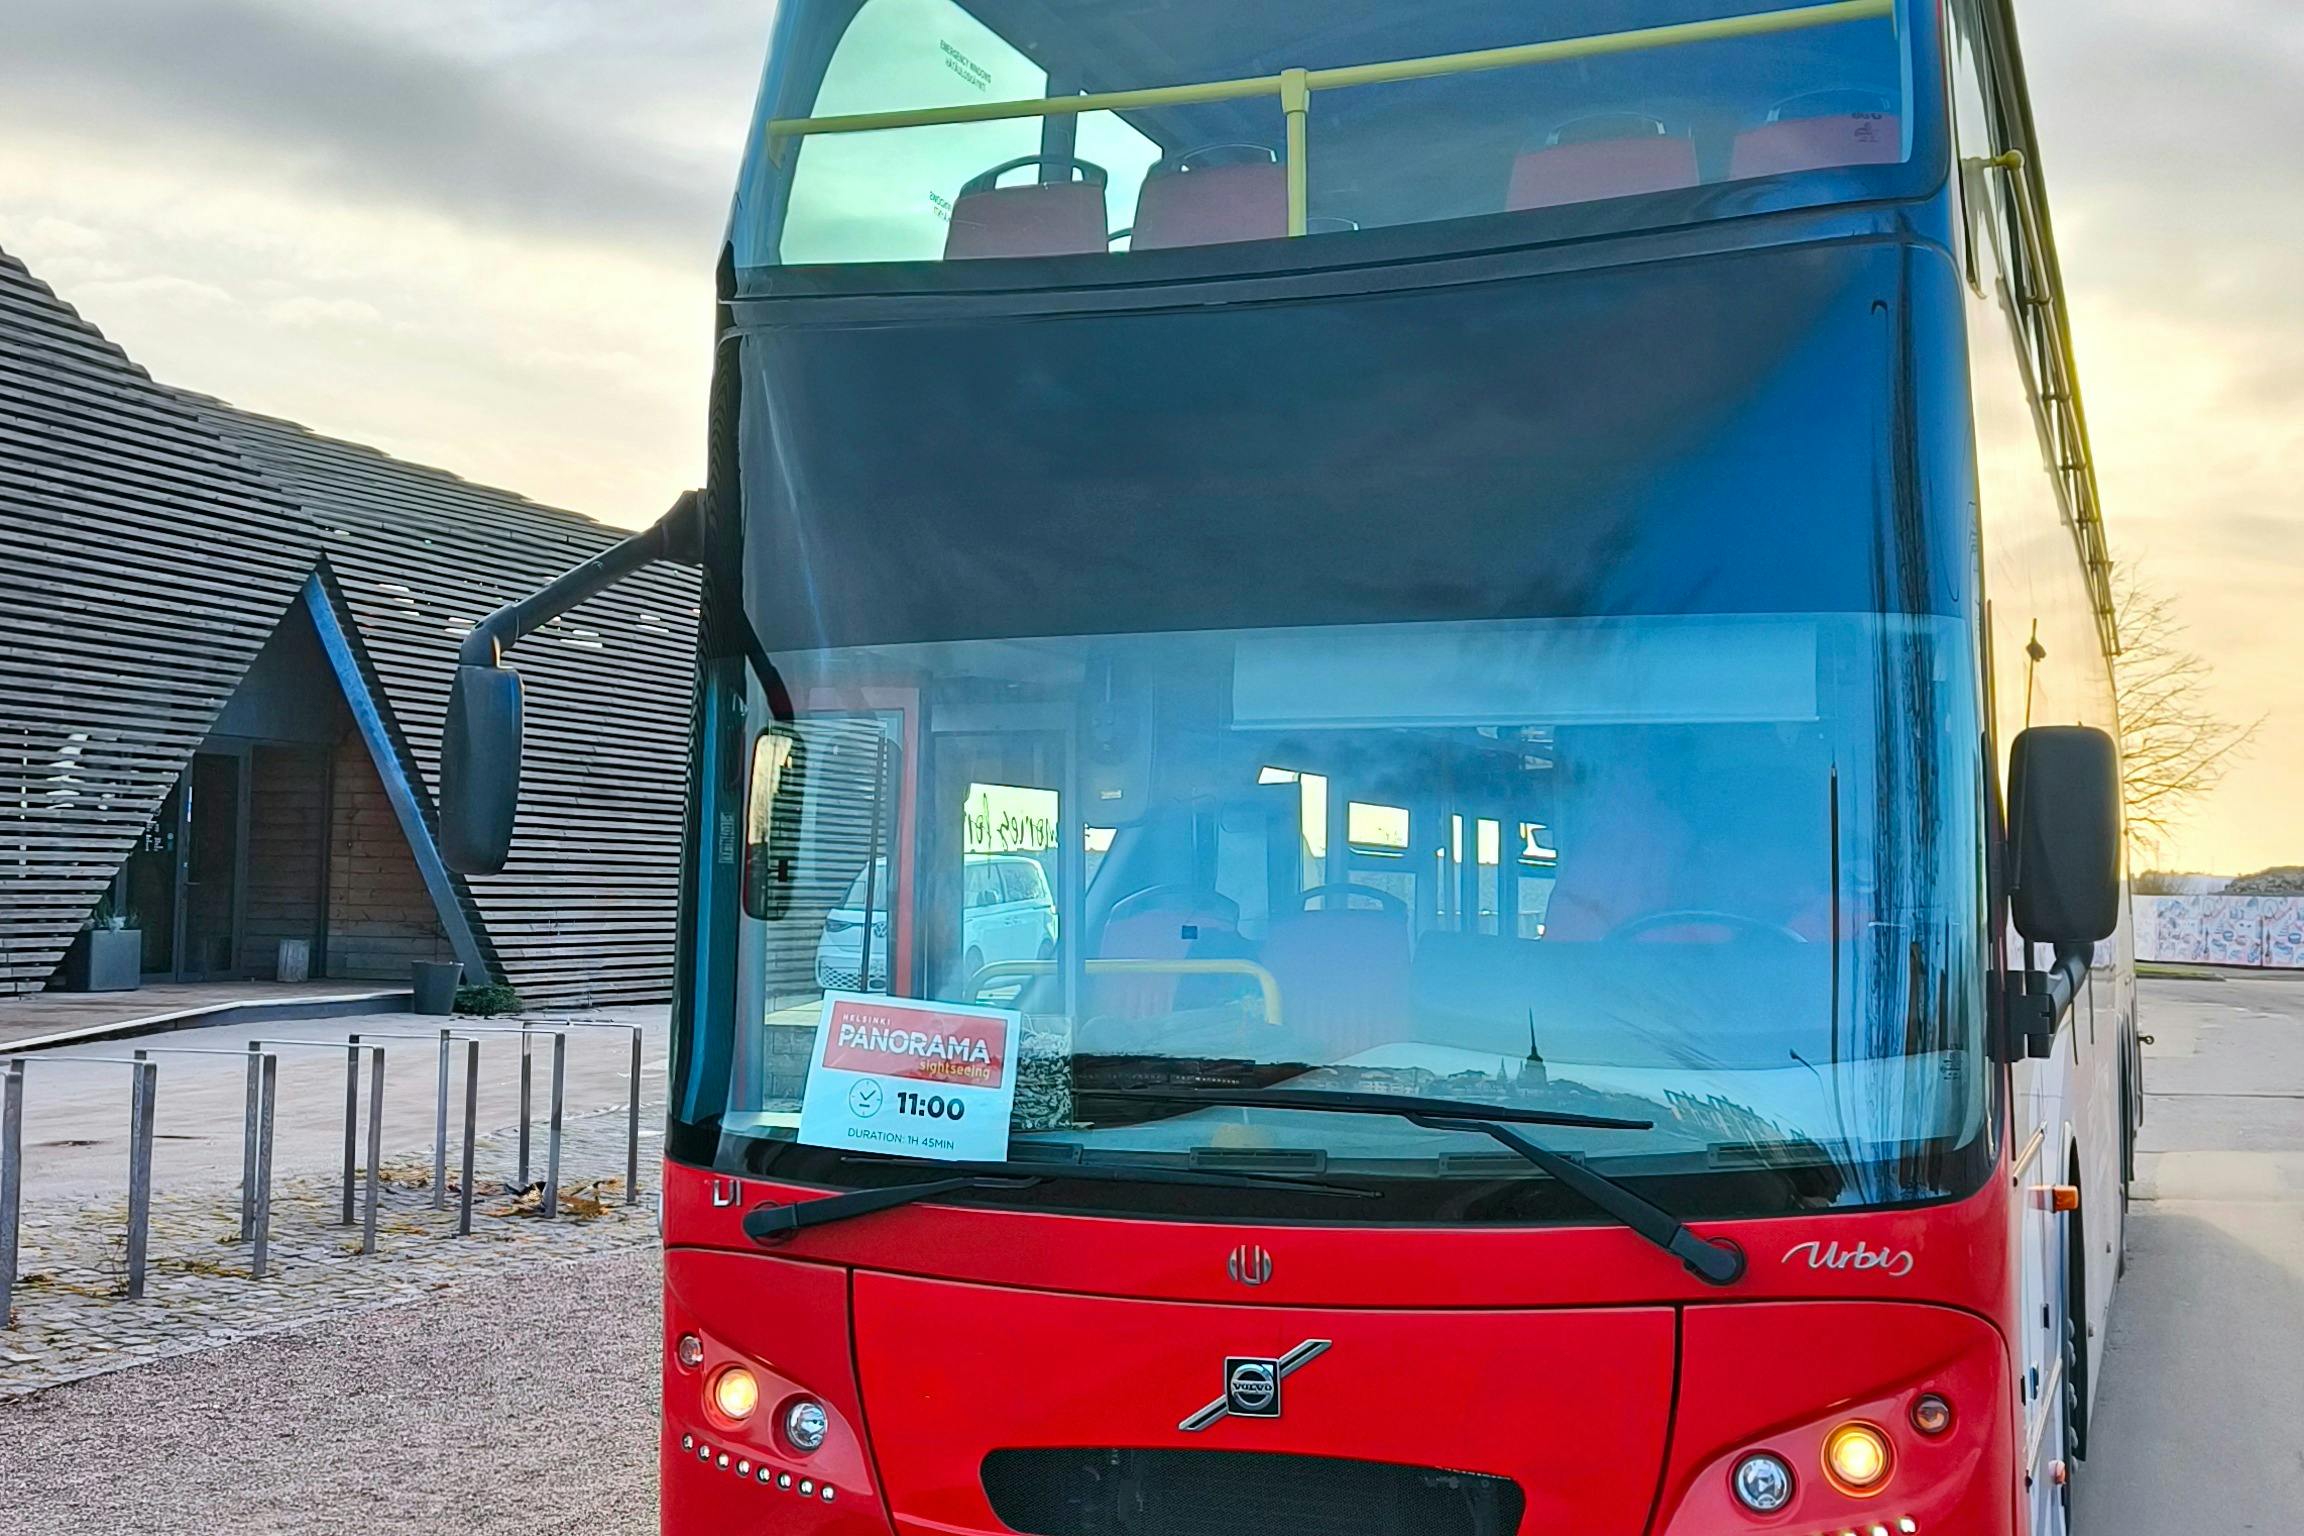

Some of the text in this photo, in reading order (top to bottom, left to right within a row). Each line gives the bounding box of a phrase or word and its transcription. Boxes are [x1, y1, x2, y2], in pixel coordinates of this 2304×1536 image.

[843, 1014, 891, 1025] HELSINKI
[838, 1023, 991, 1064] PANORAMA
[920, 1060, 991, 1079] sightseeing
[898, 1092, 965, 1120] 11:00
[847, 1127, 955, 1150] DURATION: 1H 45MIN
[1781, 1241, 1914, 1277] Urbis
[1233, 1382, 1273, 1392] VOLVO
